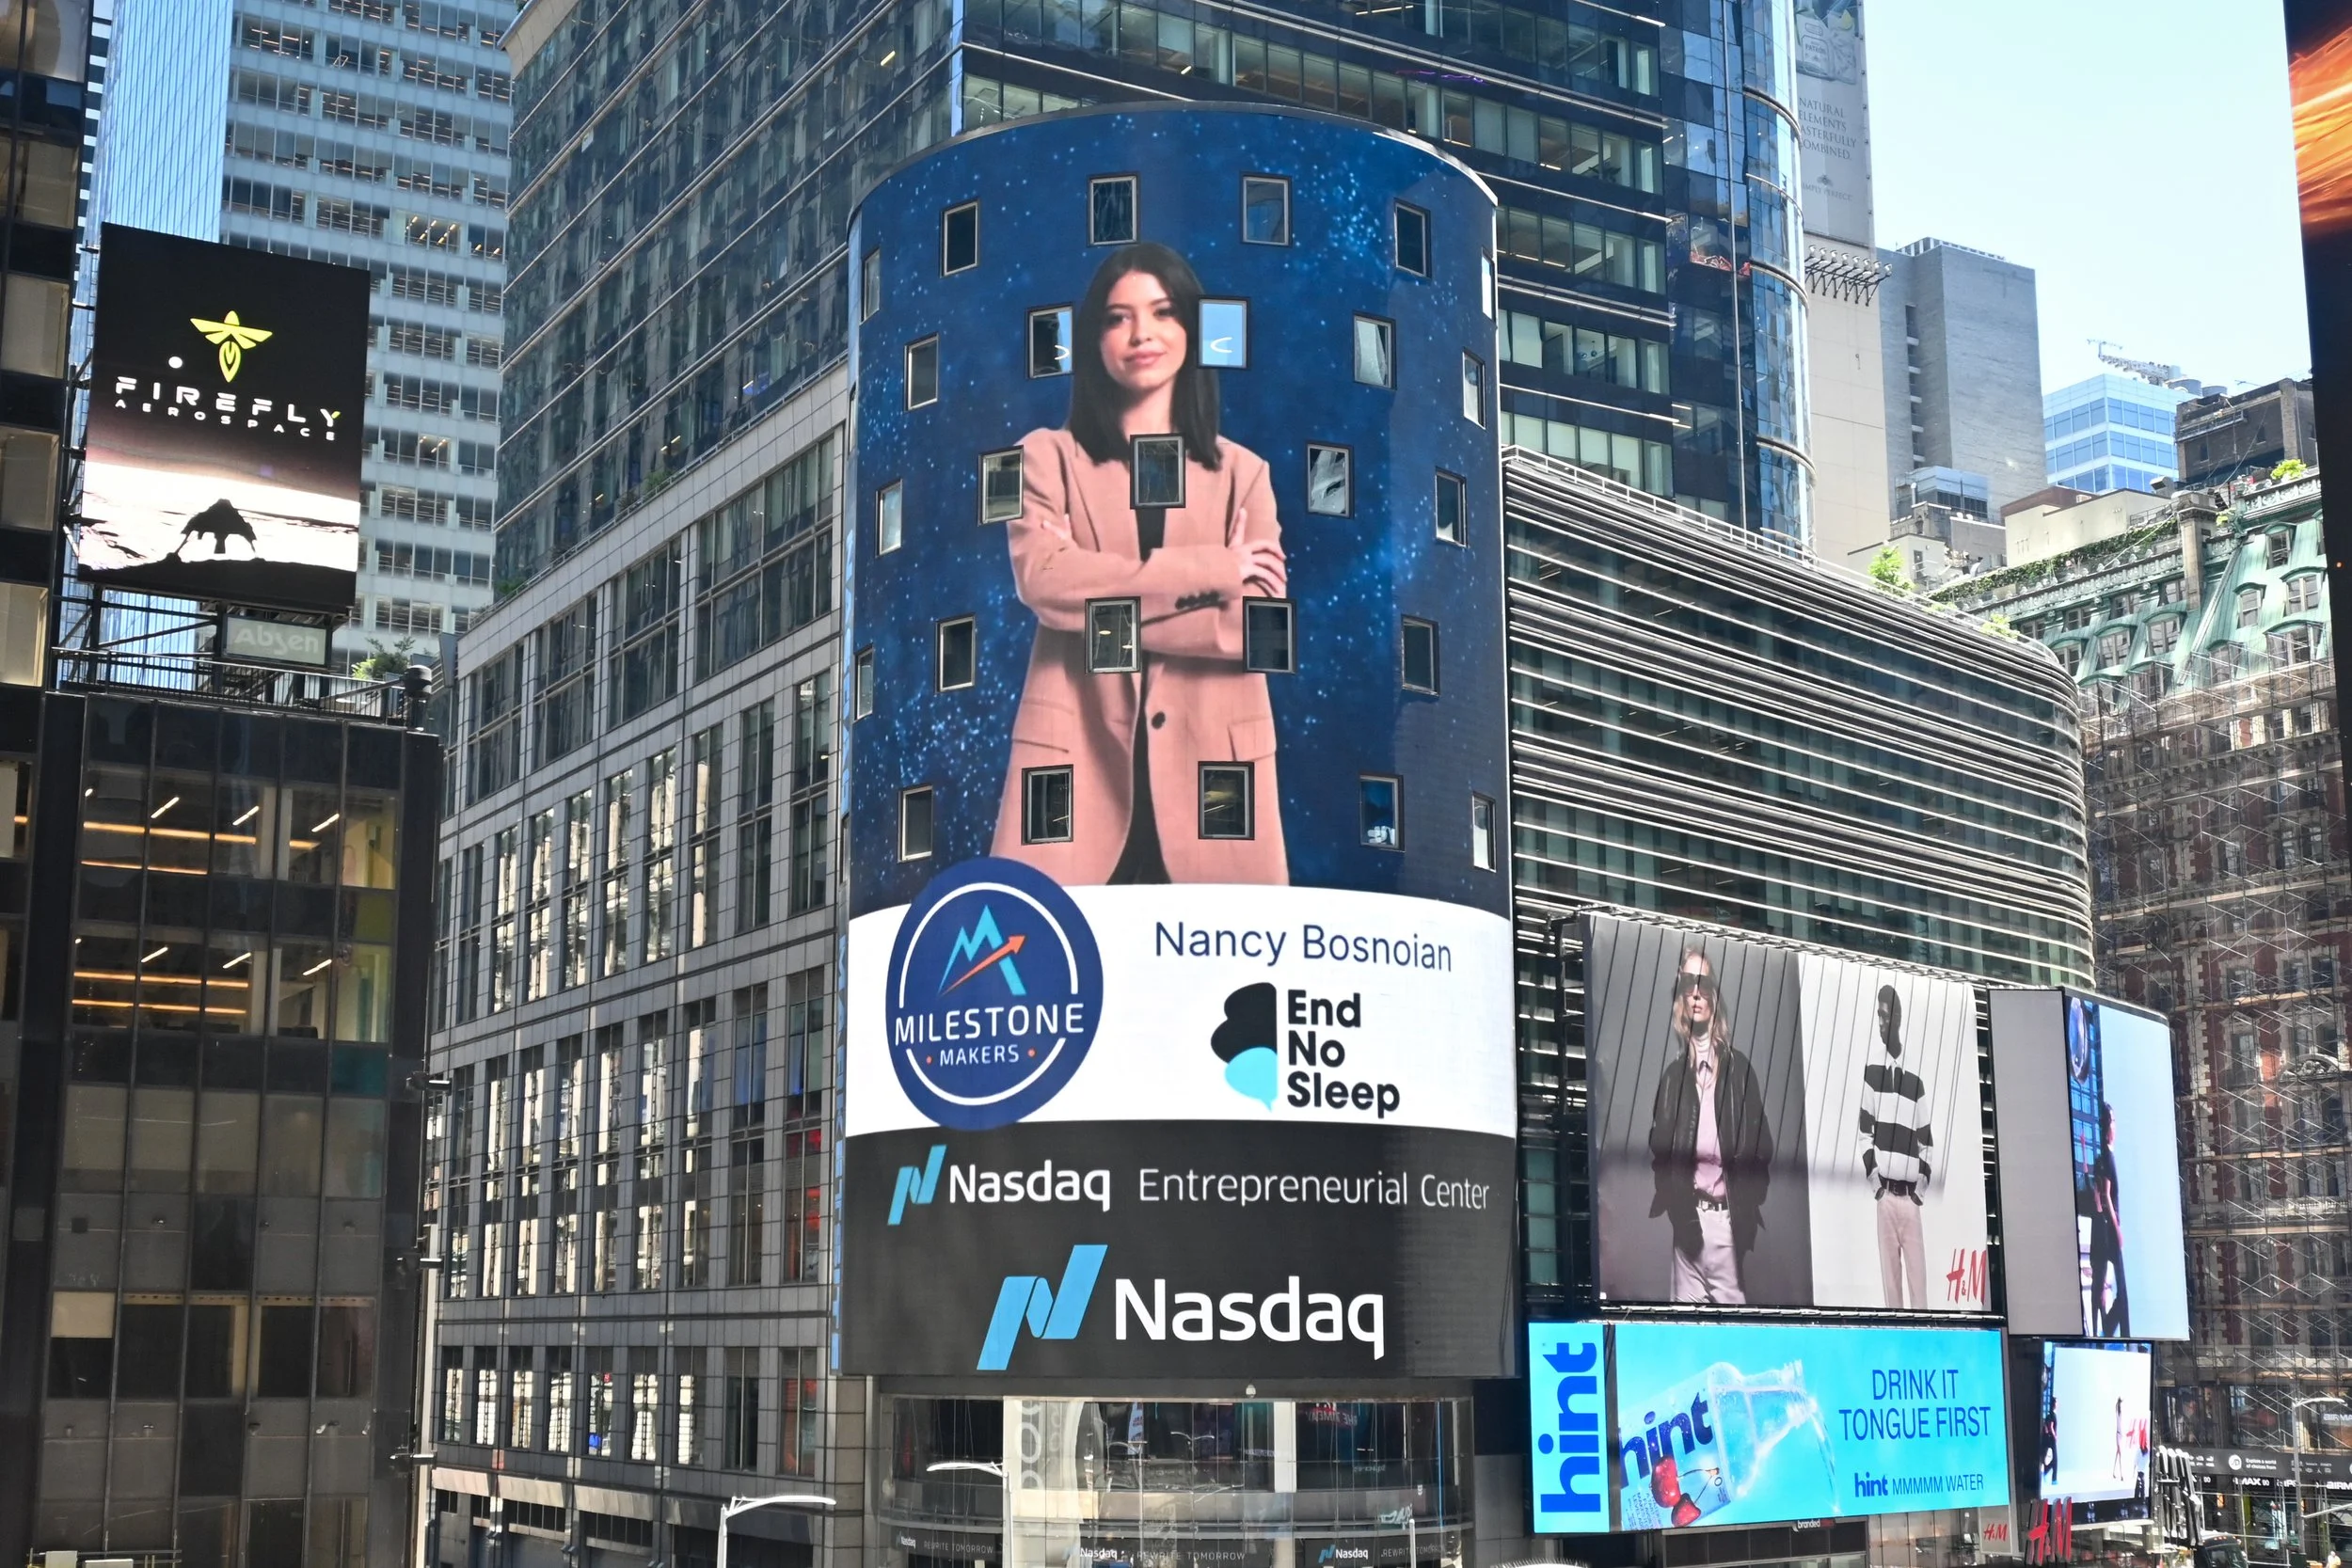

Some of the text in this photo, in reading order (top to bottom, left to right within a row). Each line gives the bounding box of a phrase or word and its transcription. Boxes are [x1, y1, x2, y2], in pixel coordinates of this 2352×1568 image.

[1799, 97, 1844, 119] NATURAL
[1799, 109, 1847, 132] ELEMENTS
[1801, 124, 1857, 149] ASTERFULLY
[1803, 138, 1851, 161] OMBINED.
[116, 376, 341, 427] FIREFLY
[115, 399, 335, 441] AEROSPACE
[233, 625, 319, 656] Absen
[1155, 921, 1452, 973] Nancy Bosnoian
[895, 1003, 1084, 1046] MILESTONE
[1287, 989, 1361, 1027] End
[940, 1044, 1020, 1067] MAKERS
[1288, 1030, 1345, 1068] No
[1287, 1070, 1400, 1118] Sleep
[949, 1160, 1490, 1212] Nasdaq Entrepreneurial Center
[1946, 1248, 1987, 1306] H&M
[1115, 1276, 1384, 1360] Nasdaq
[1872, 1370, 1959, 1401] DRINK IT
[1537, 1342, 1601, 1513] hint
[1619, 1392, 1714, 1489] hint
[1838, 1406, 1992, 1441] TONGUE FIRST
[1854, 1471, 1984, 1497] hint MMMMM WATER
[951, 1544, 993, 1554] TOMORROW
[1983, 1523, 2009, 1542] H&M
[2027, 1497, 2073, 1566] H&M
[1079, 1547, 1118, 1560] Nasdaq
[1187, 1551, 1246, 1561] TOMORROW
[1335, 1547, 1369, 1560] Nasdaq
[1383, 1548, 1409, 1558] REWRIT
